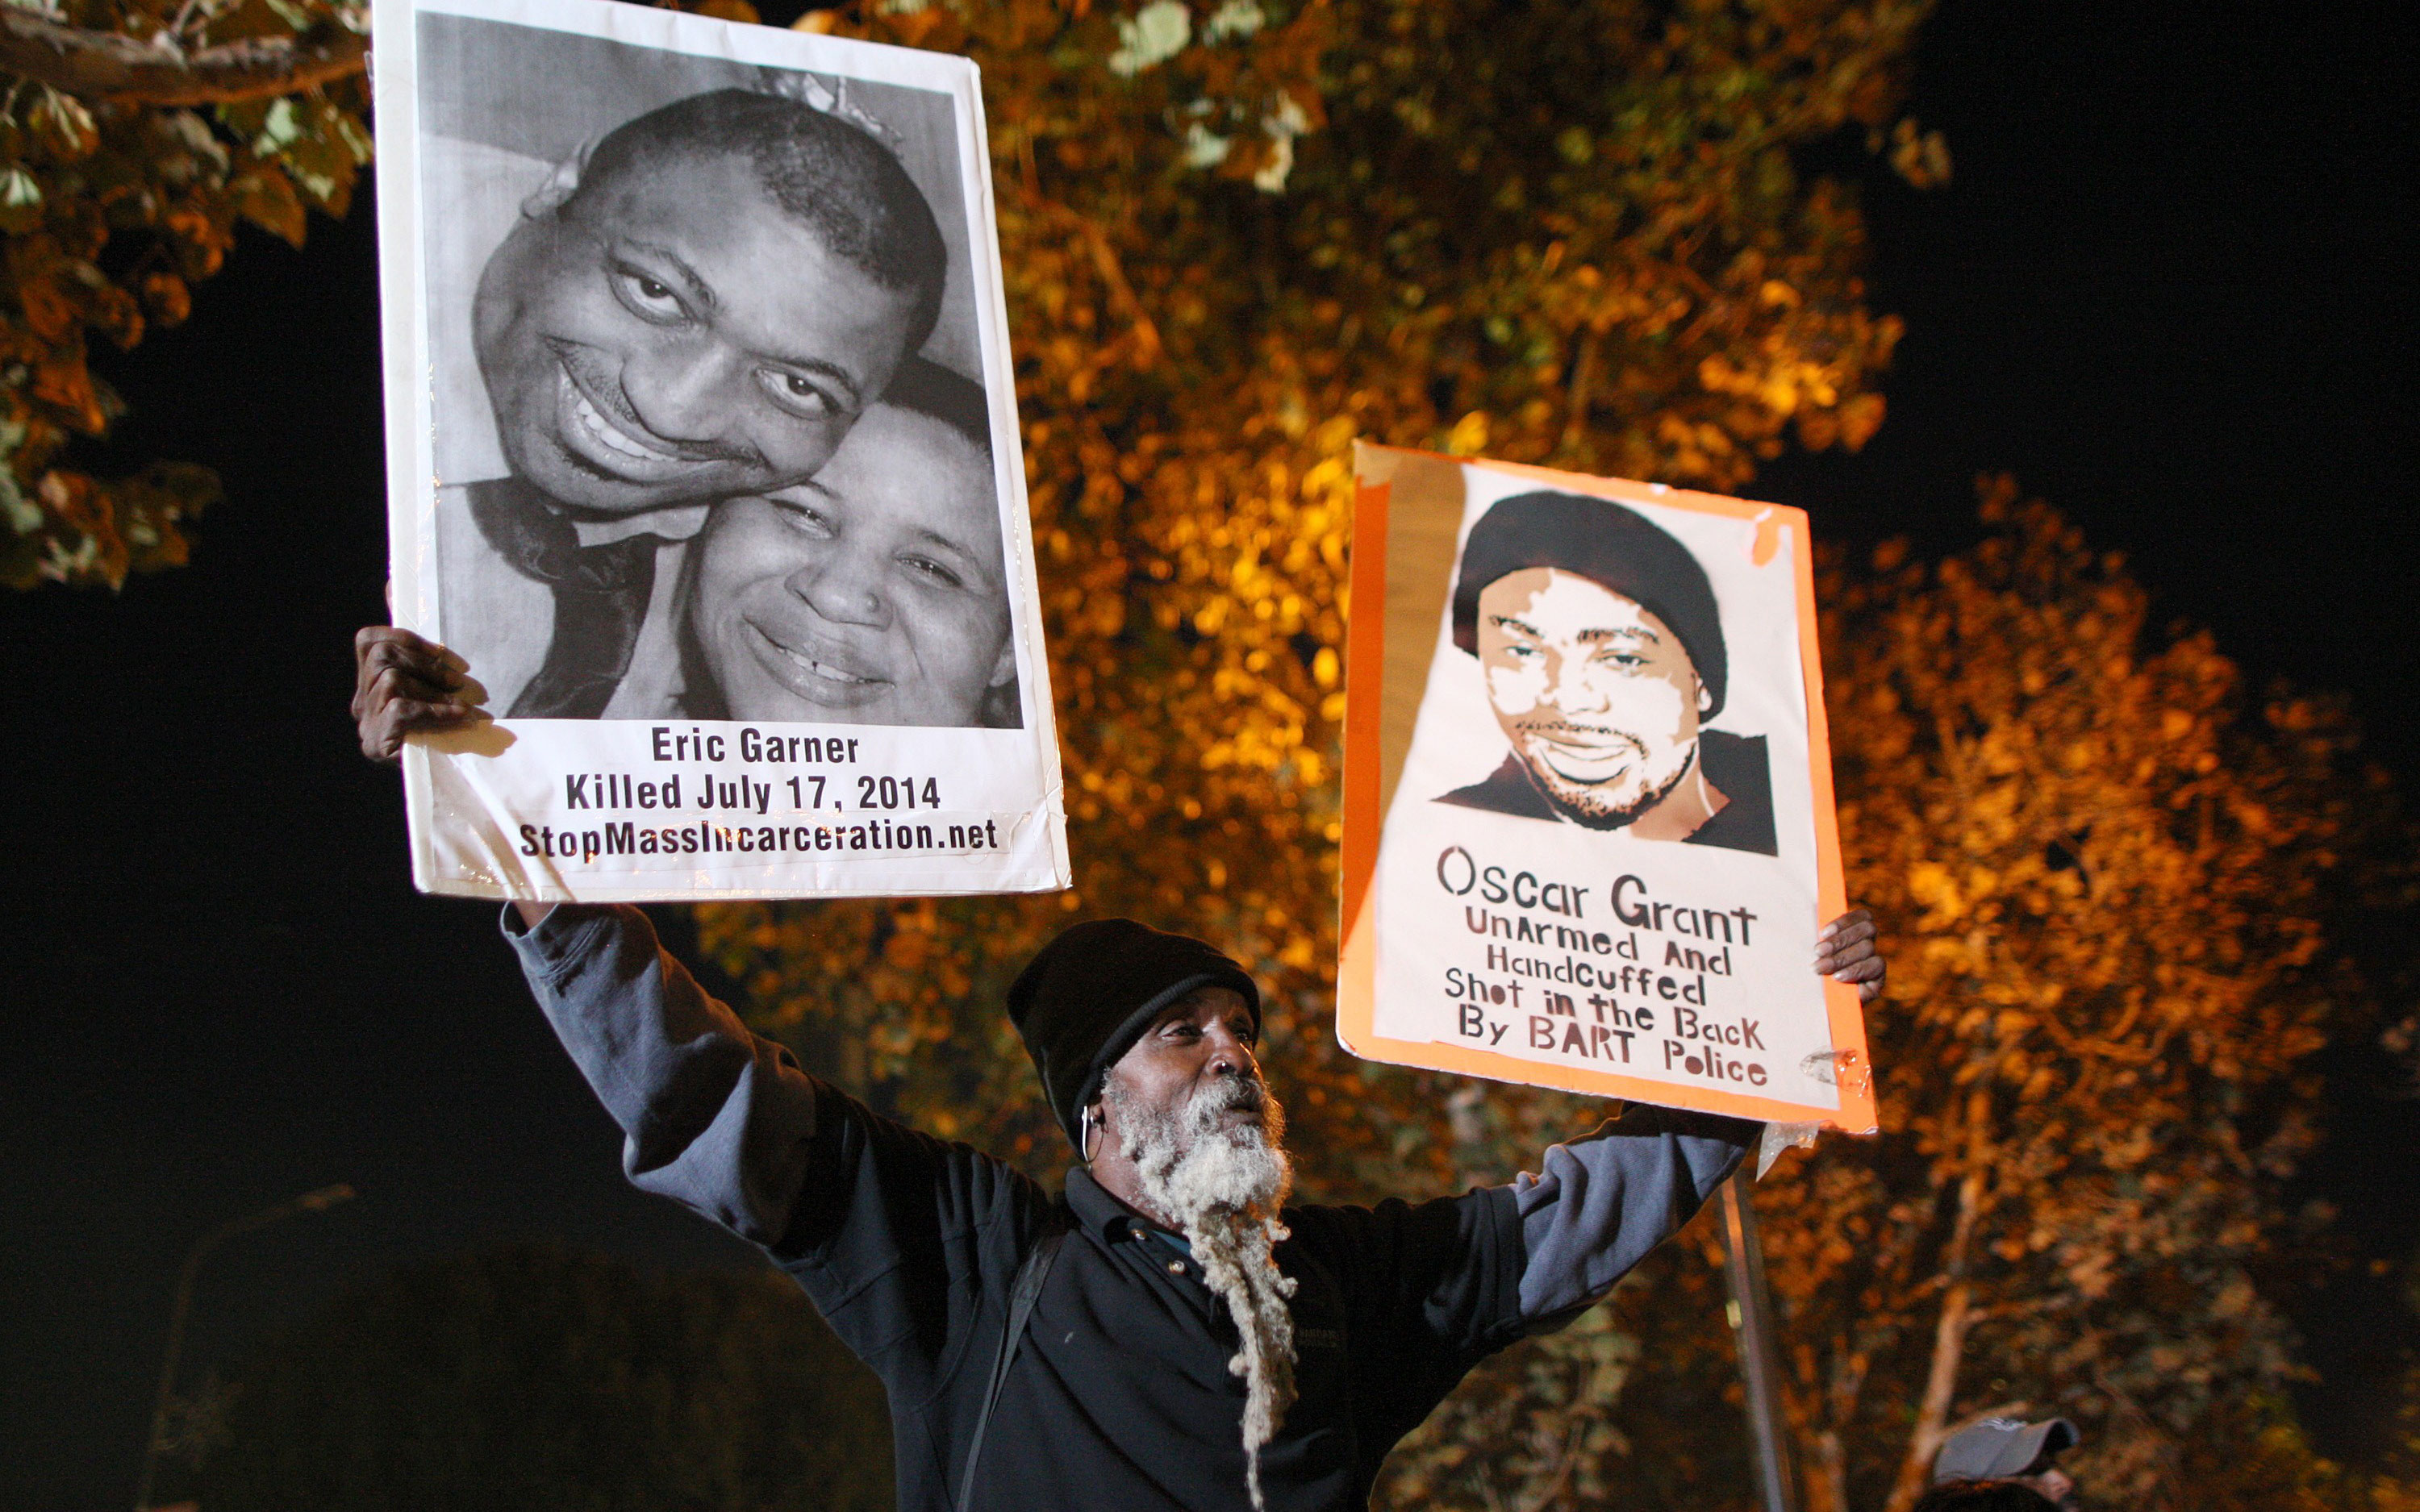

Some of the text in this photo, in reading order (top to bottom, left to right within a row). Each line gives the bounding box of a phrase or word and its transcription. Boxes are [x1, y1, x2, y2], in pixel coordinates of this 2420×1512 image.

[652, 727, 858, 764] Eric Garner
[566, 773, 941, 814] Killed July 17, 2014
[519, 819, 998, 864] StopMassIncarceration.net
[1437, 845, 1758, 946] Oscar Grant
[1487, 943, 1707, 1006] Handcuffed
[1664, 940, 1732, 976] And
[1445, 967, 1524, 1009] Shot
[1544, 989, 1576, 1018] in
[1588, 992, 1655, 1031] the
[1458, 1003, 1768, 1087] By BART Police
